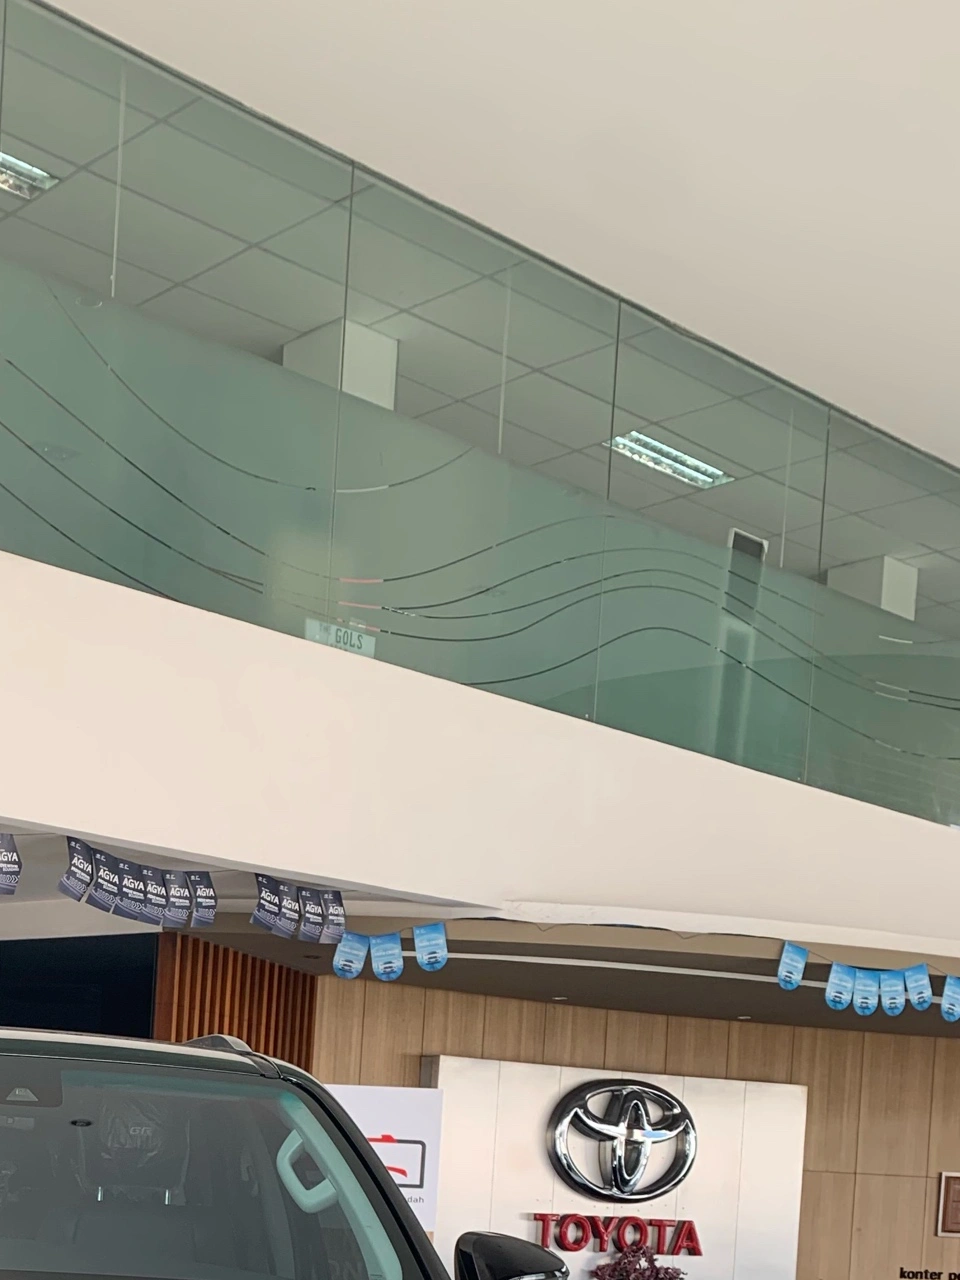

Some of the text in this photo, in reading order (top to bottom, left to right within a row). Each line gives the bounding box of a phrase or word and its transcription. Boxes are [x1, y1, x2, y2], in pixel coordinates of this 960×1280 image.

[72, 857, 92, 874] AGYA
[98, 868, 119, 884] AGYA
[123, 878, 144, 891] AGYA
[147, 884, 166, 896] AGYA
[170, 888, 190, 897] AGYA
[196, 888, 215, 896] AGYA
[260, 890, 279, 905] AGYA
[282, 899, 299, 911] AGYA
[306, 904, 322, 914] AGYA
[329, 906, 344, 914] AGYA
[534, 1213, 703, 1256] TOYOTA
[900, 1267, 943, 1280] konter
